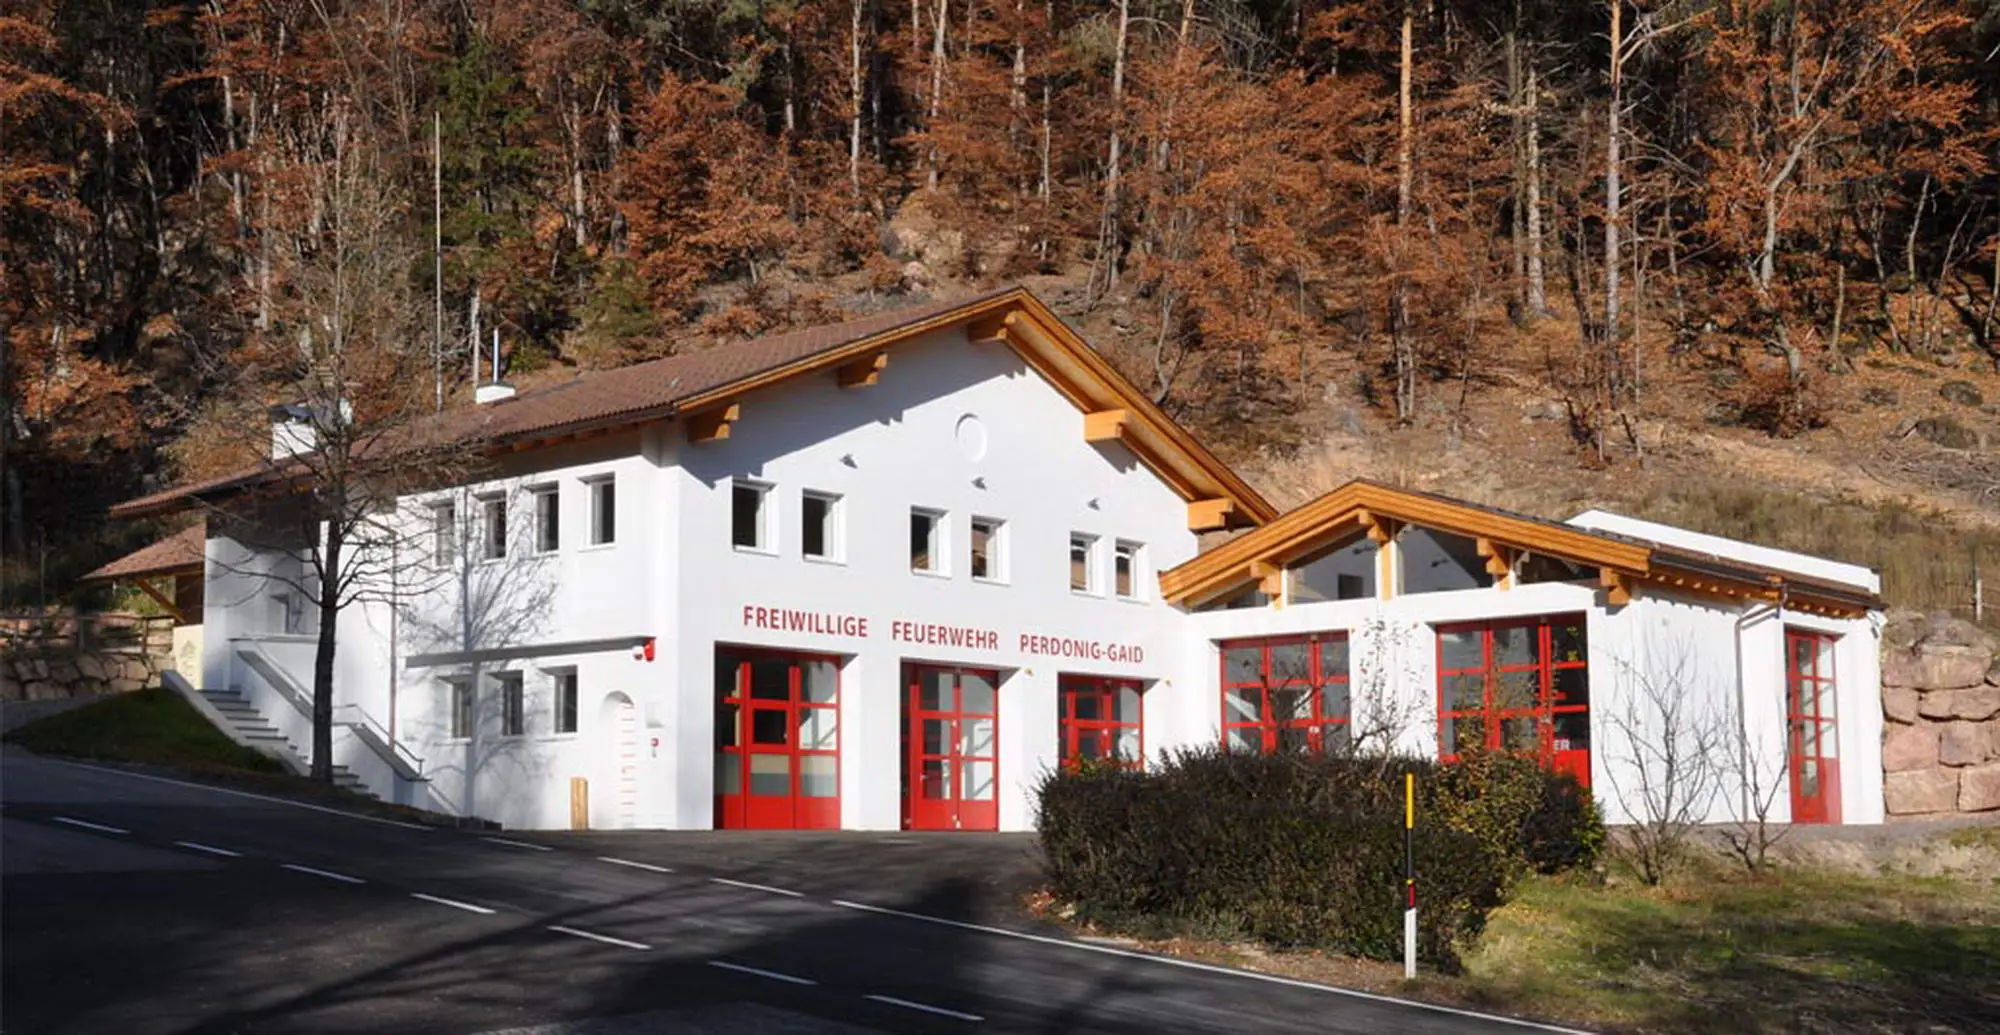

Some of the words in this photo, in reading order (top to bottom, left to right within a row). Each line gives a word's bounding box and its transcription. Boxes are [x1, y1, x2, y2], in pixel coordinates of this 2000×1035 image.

[743, 605, 868, 637] FREIWILLIGE
[891, 621, 999, 651] FEUERWEHR
[1019, 634, 1144, 664] PERDONIG-GAID
